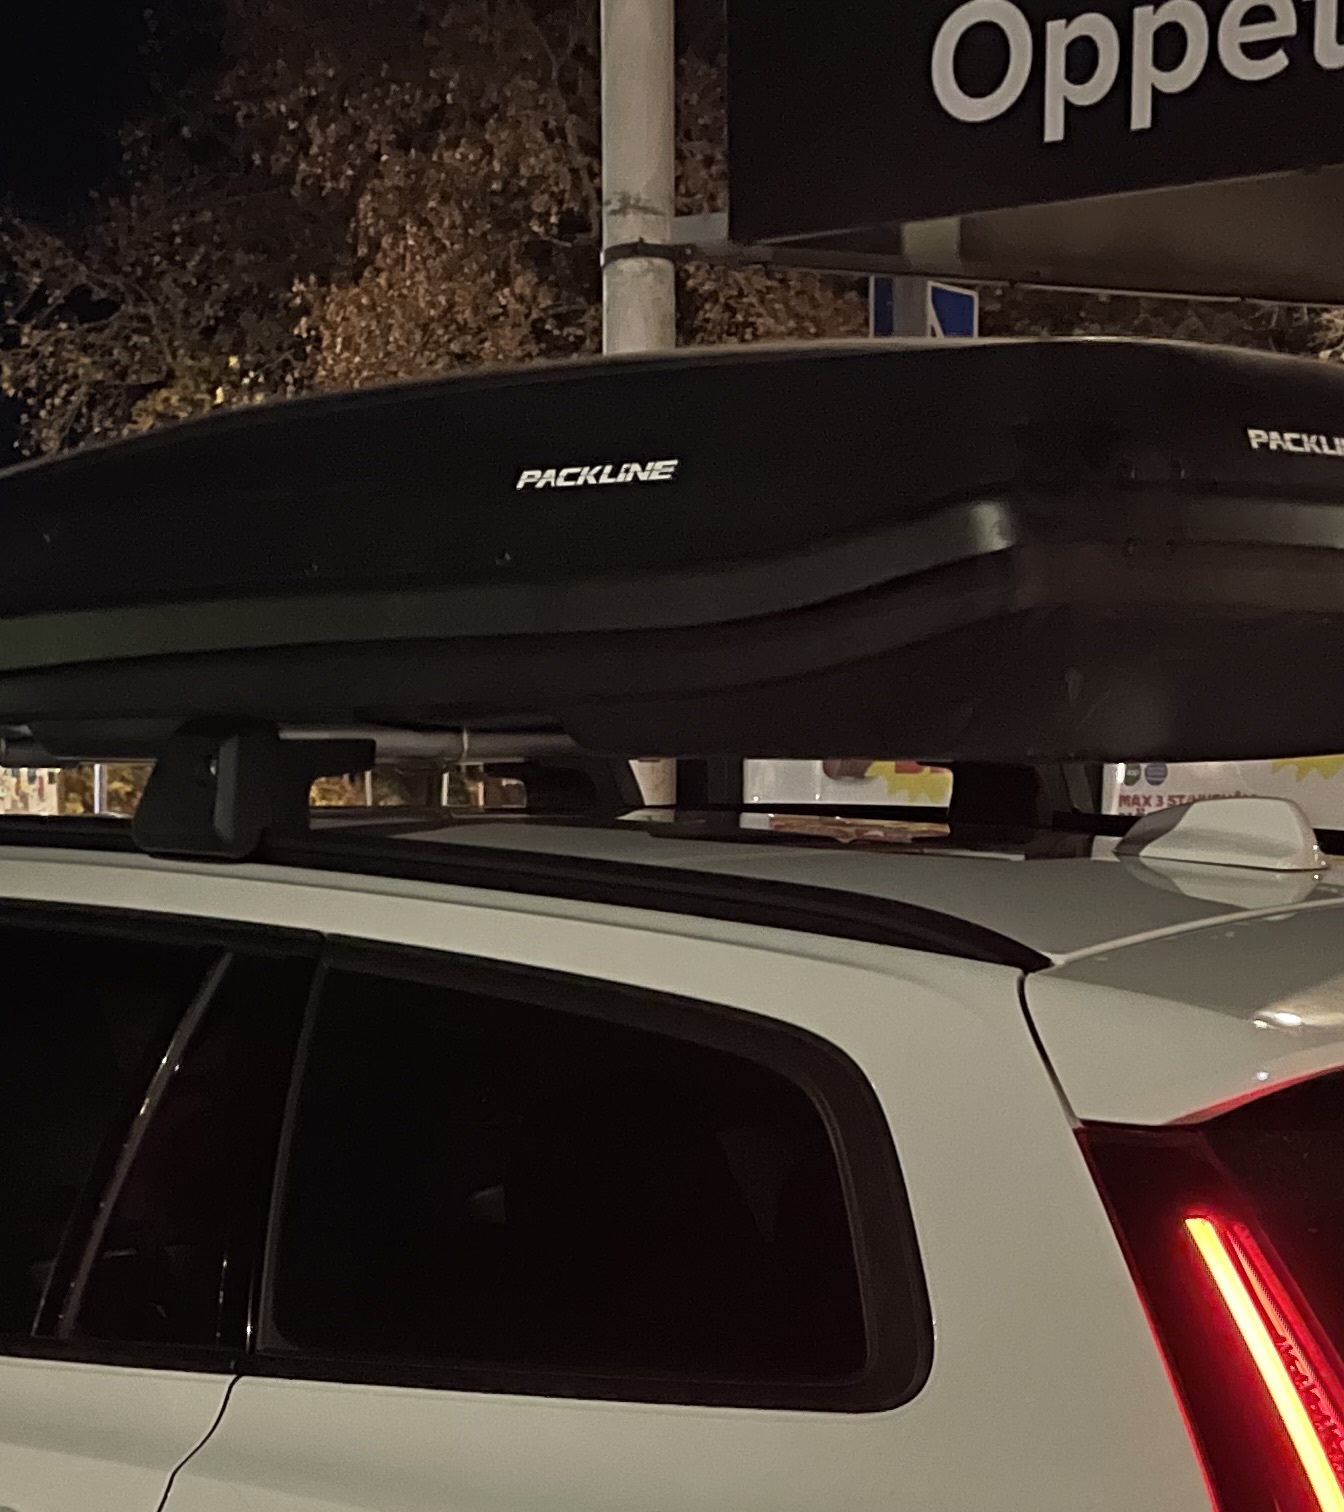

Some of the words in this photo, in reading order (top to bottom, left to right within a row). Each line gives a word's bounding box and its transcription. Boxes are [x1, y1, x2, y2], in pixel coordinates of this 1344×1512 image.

[516, 459, 678, 490] PACKLINE
[1119, 794, 1153, 808] MAX
[1156, 794, 1164, 807] 3
